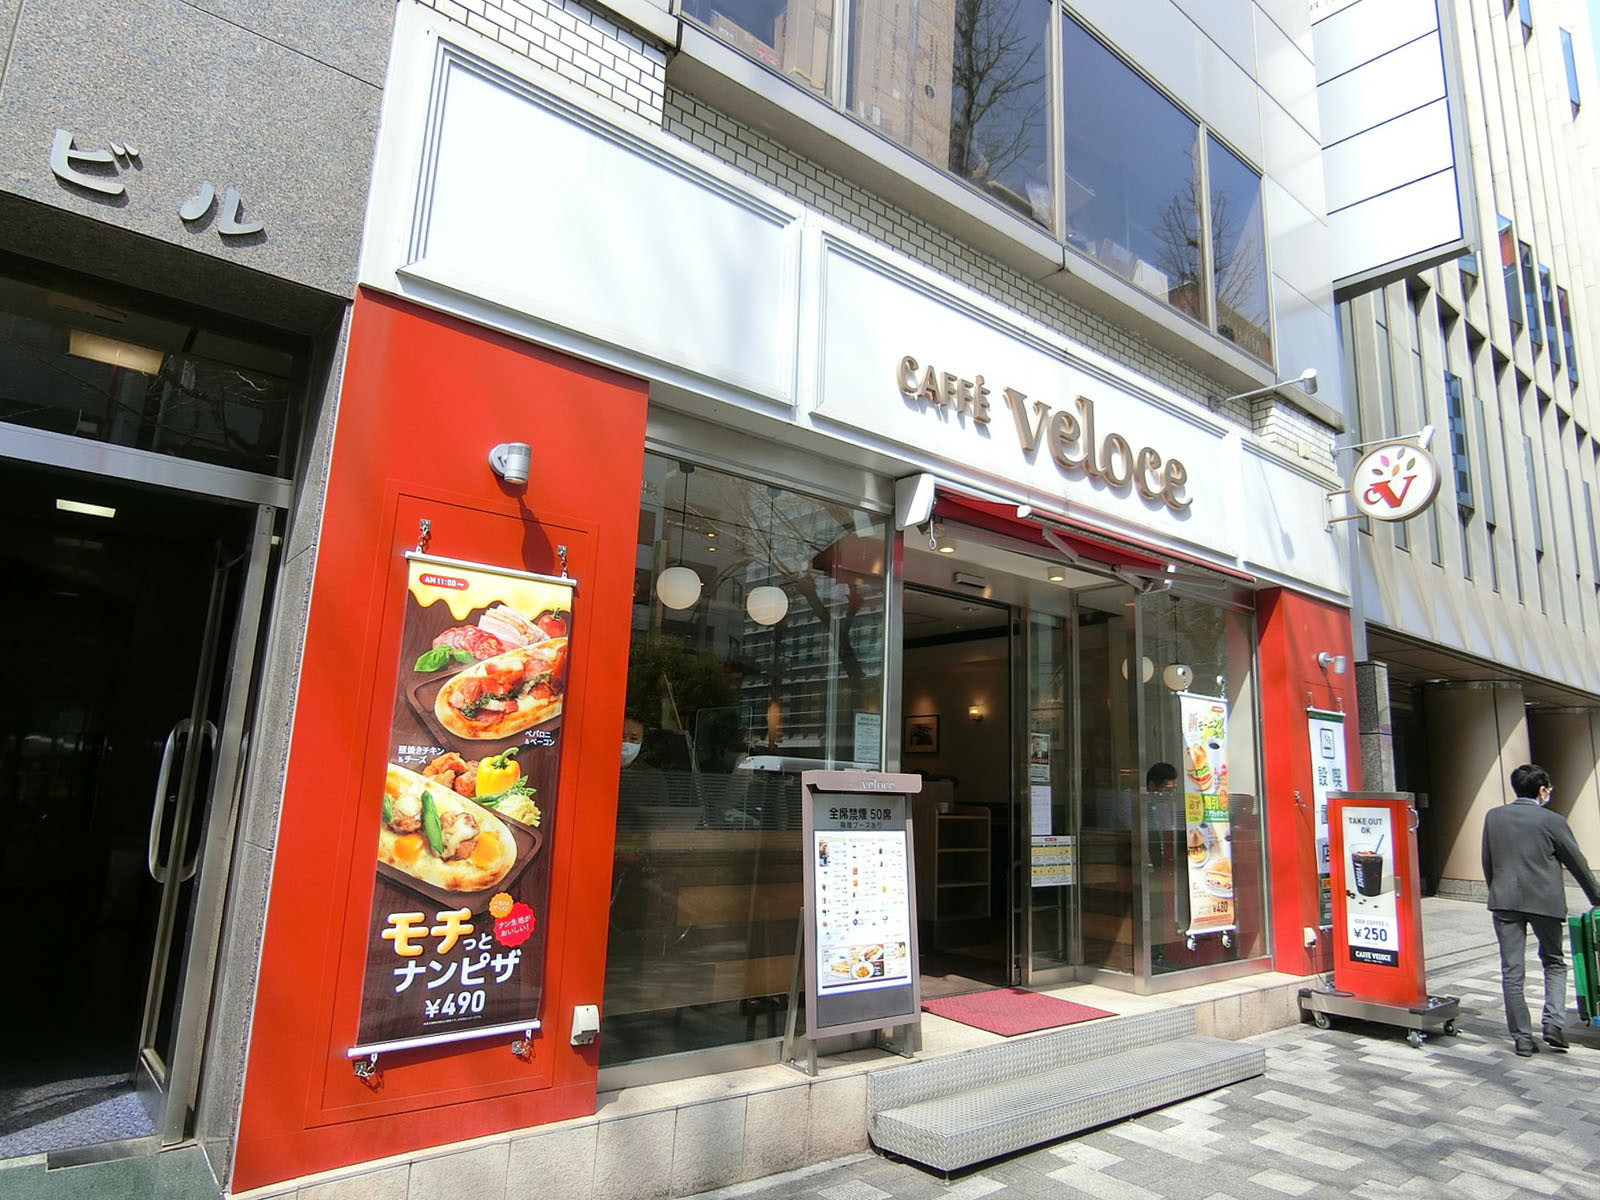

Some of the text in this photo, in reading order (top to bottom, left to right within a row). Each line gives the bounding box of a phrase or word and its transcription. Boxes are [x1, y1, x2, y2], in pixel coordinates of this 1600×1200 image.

[49, 127, 264, 235] ビル
[829, 807, 892, 820] 全席禁煙 50席
[1348, 817, 1367, 825] TAKE
[1353, 926, 1388, 942] ¥250
[393, 949, 522, 993] ナンピザ
[424, 990, 486, 1018] ¥490
